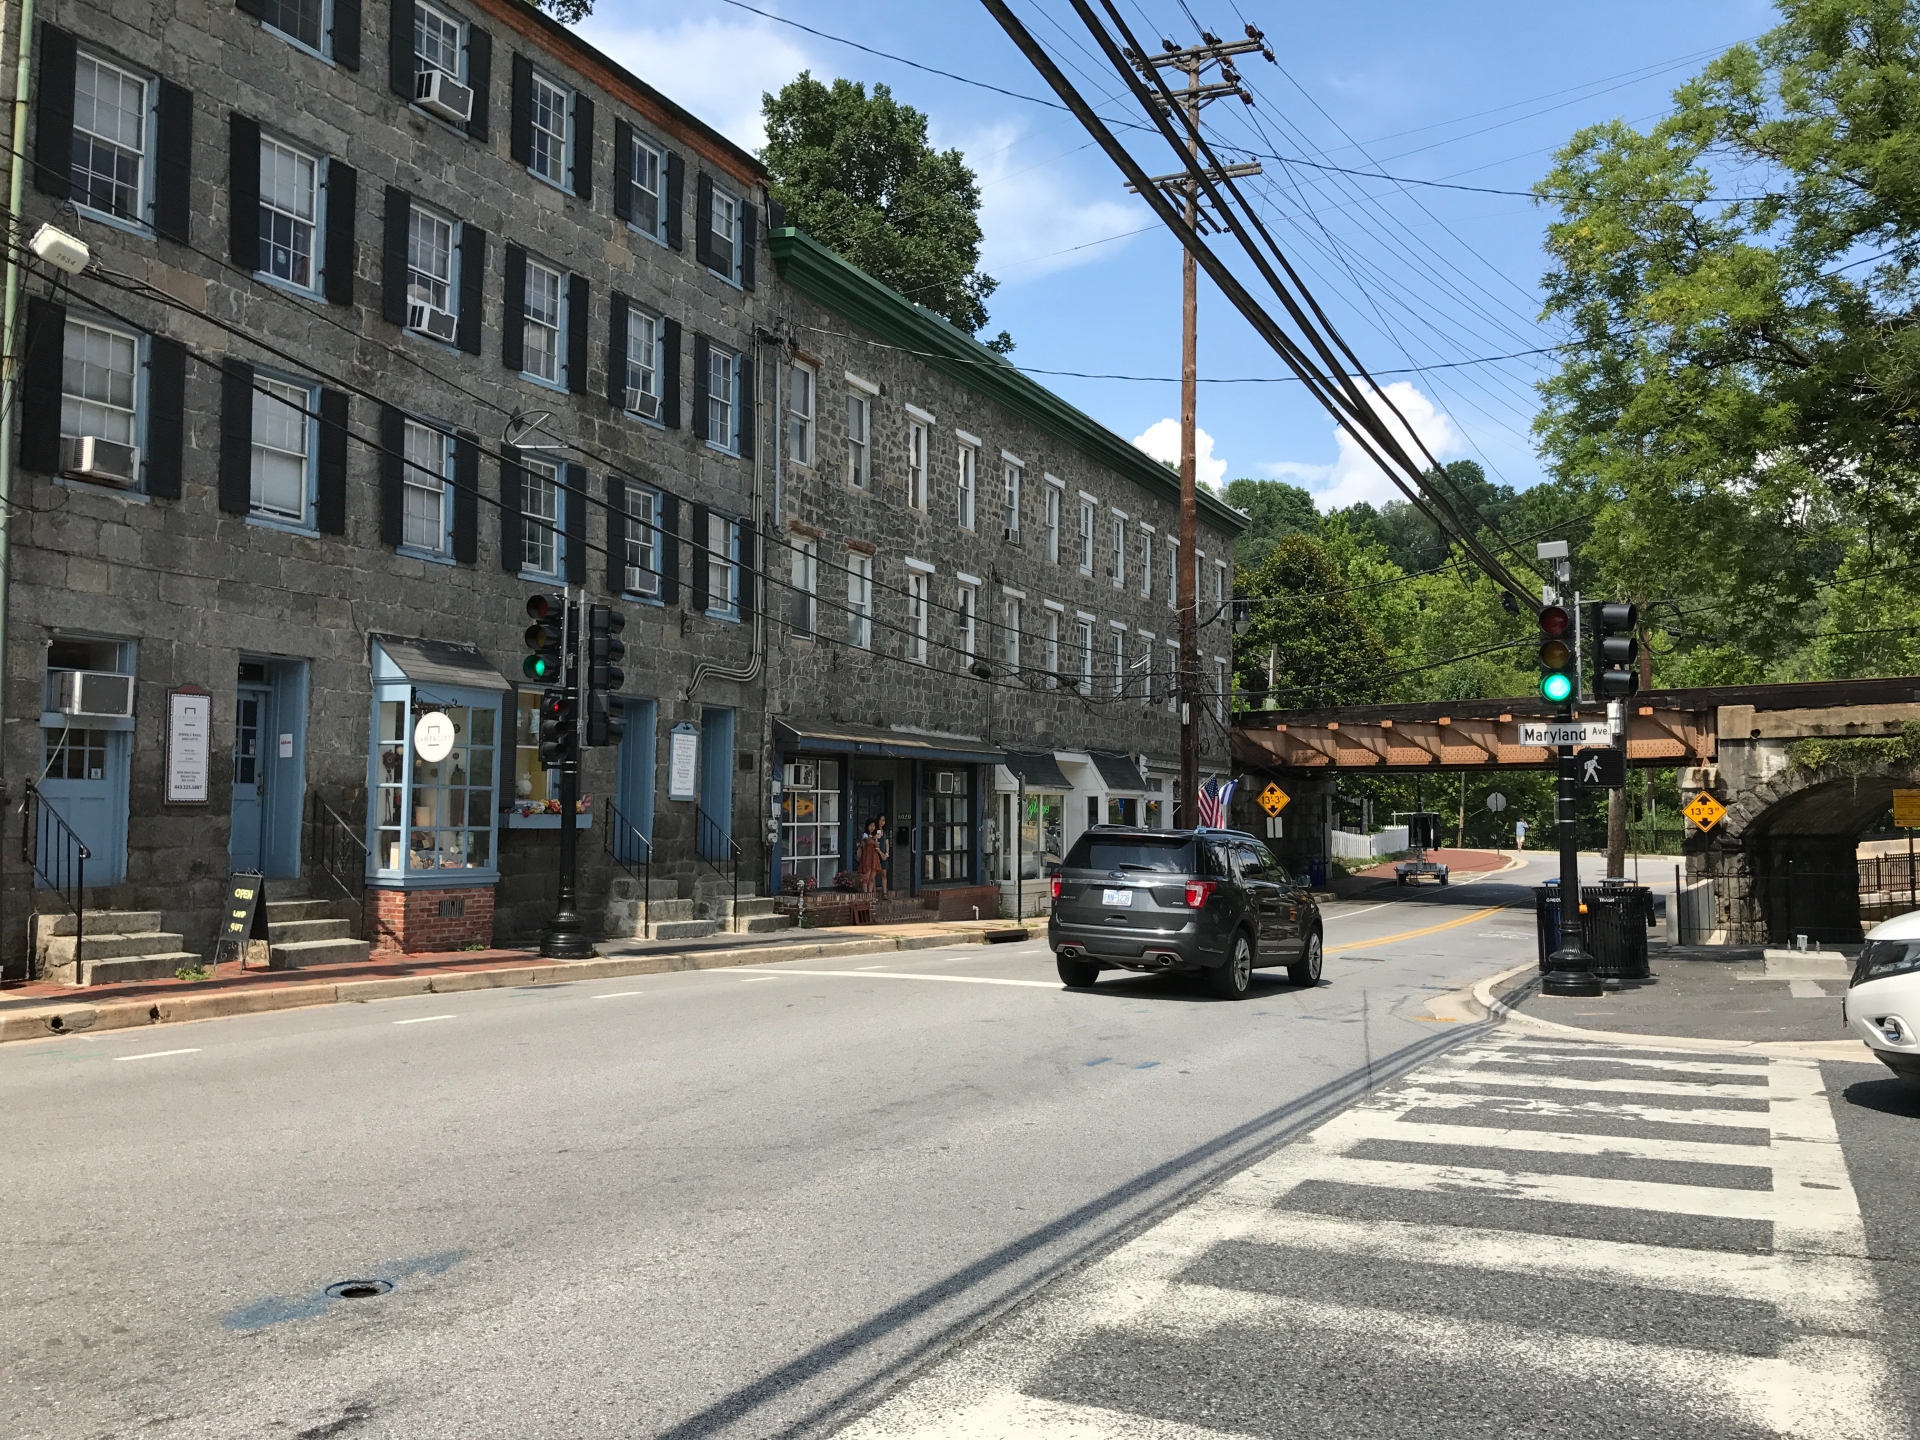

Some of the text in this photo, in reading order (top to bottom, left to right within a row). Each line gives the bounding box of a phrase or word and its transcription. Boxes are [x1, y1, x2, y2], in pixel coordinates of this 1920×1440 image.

[416, 734, 452, 743] LAMP&GIFT
[1524, 727, 1611, 743] Maryland Ave.
[234, 888, 254, 900] OPEN
